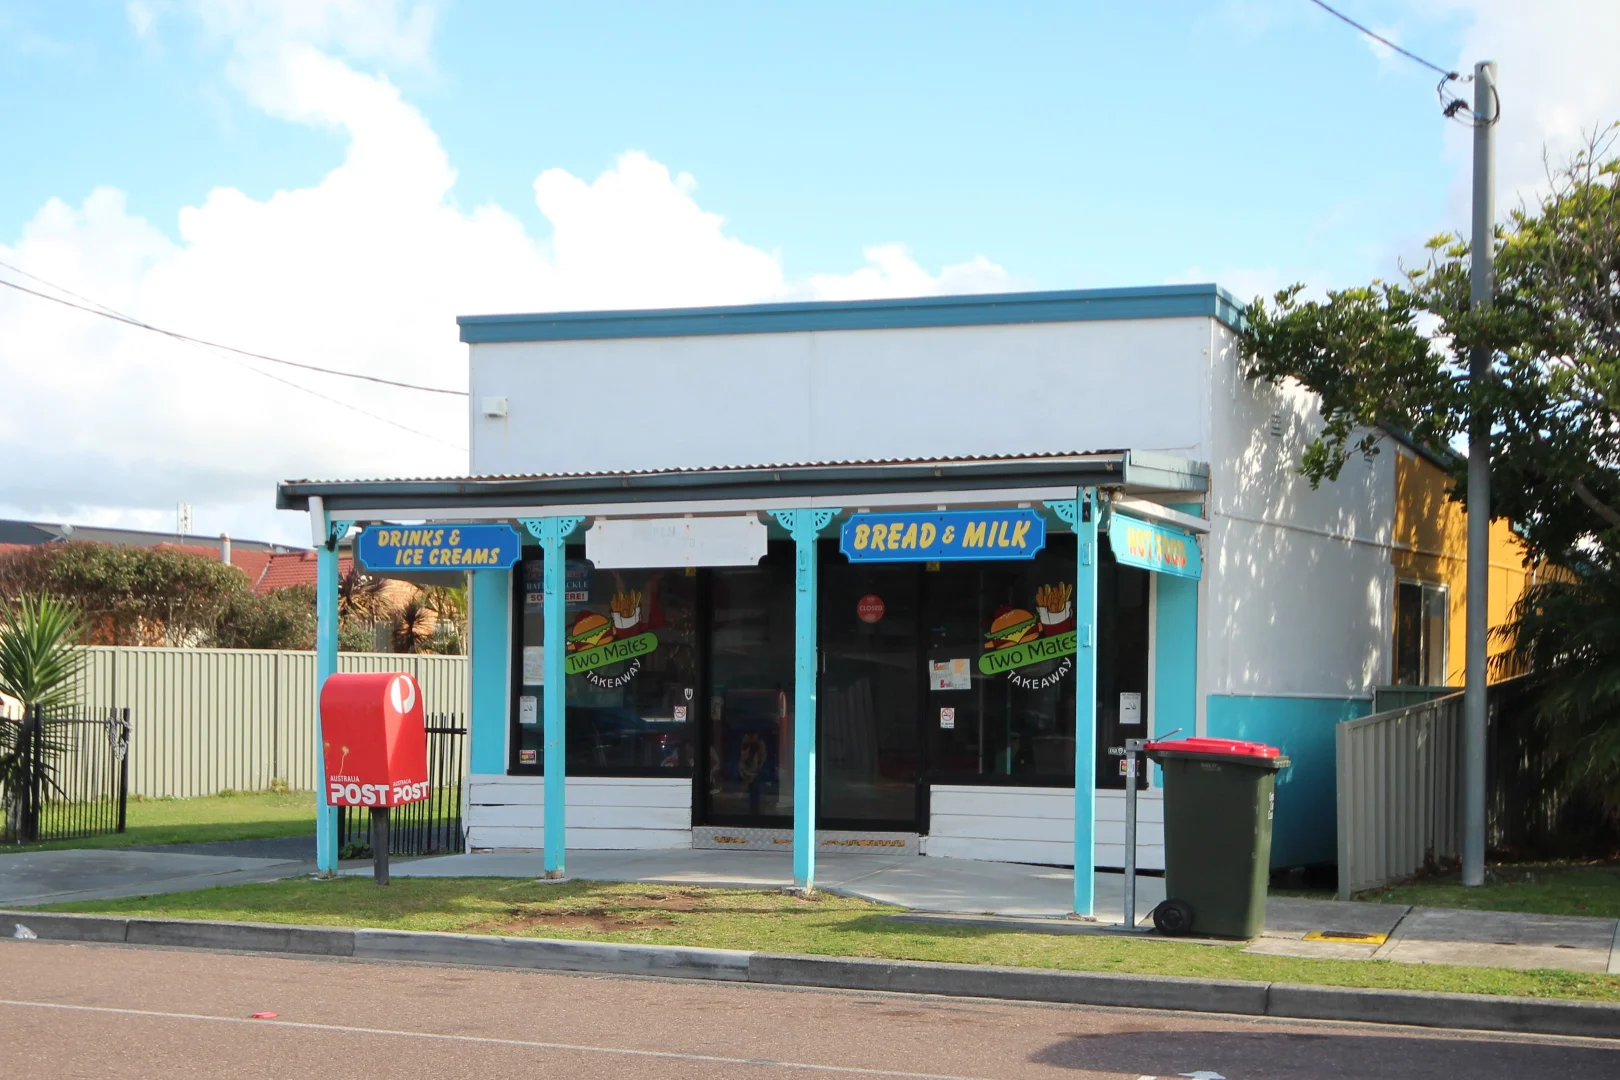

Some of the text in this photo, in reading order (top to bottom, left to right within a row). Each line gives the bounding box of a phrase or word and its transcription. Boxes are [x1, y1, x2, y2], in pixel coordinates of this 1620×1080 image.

[378, 529, 460, 547] DRINKS &
[853, 520, 1031, 551] BREAD & MILK
[1127, 526, 1187, 568] HOT FOOD
[395, 547, 500, 565] ICE CREAMS
[859, 604, 883, 612] CLOSED
[568, 638, 649, 671] Two Mates
[985, 635, 1077, 670] Two Mates
[586, 658, 641, 688] TAKEAWAY
[1007, 656, 1072, 690] TAKEAWAY
[330, 775, 360, 783] AUSTRALIA
[393, 778, 412, 787] AUSTRALIA
[330, 783, 390, 805] POST
[393, 781, 430, 804] POST
